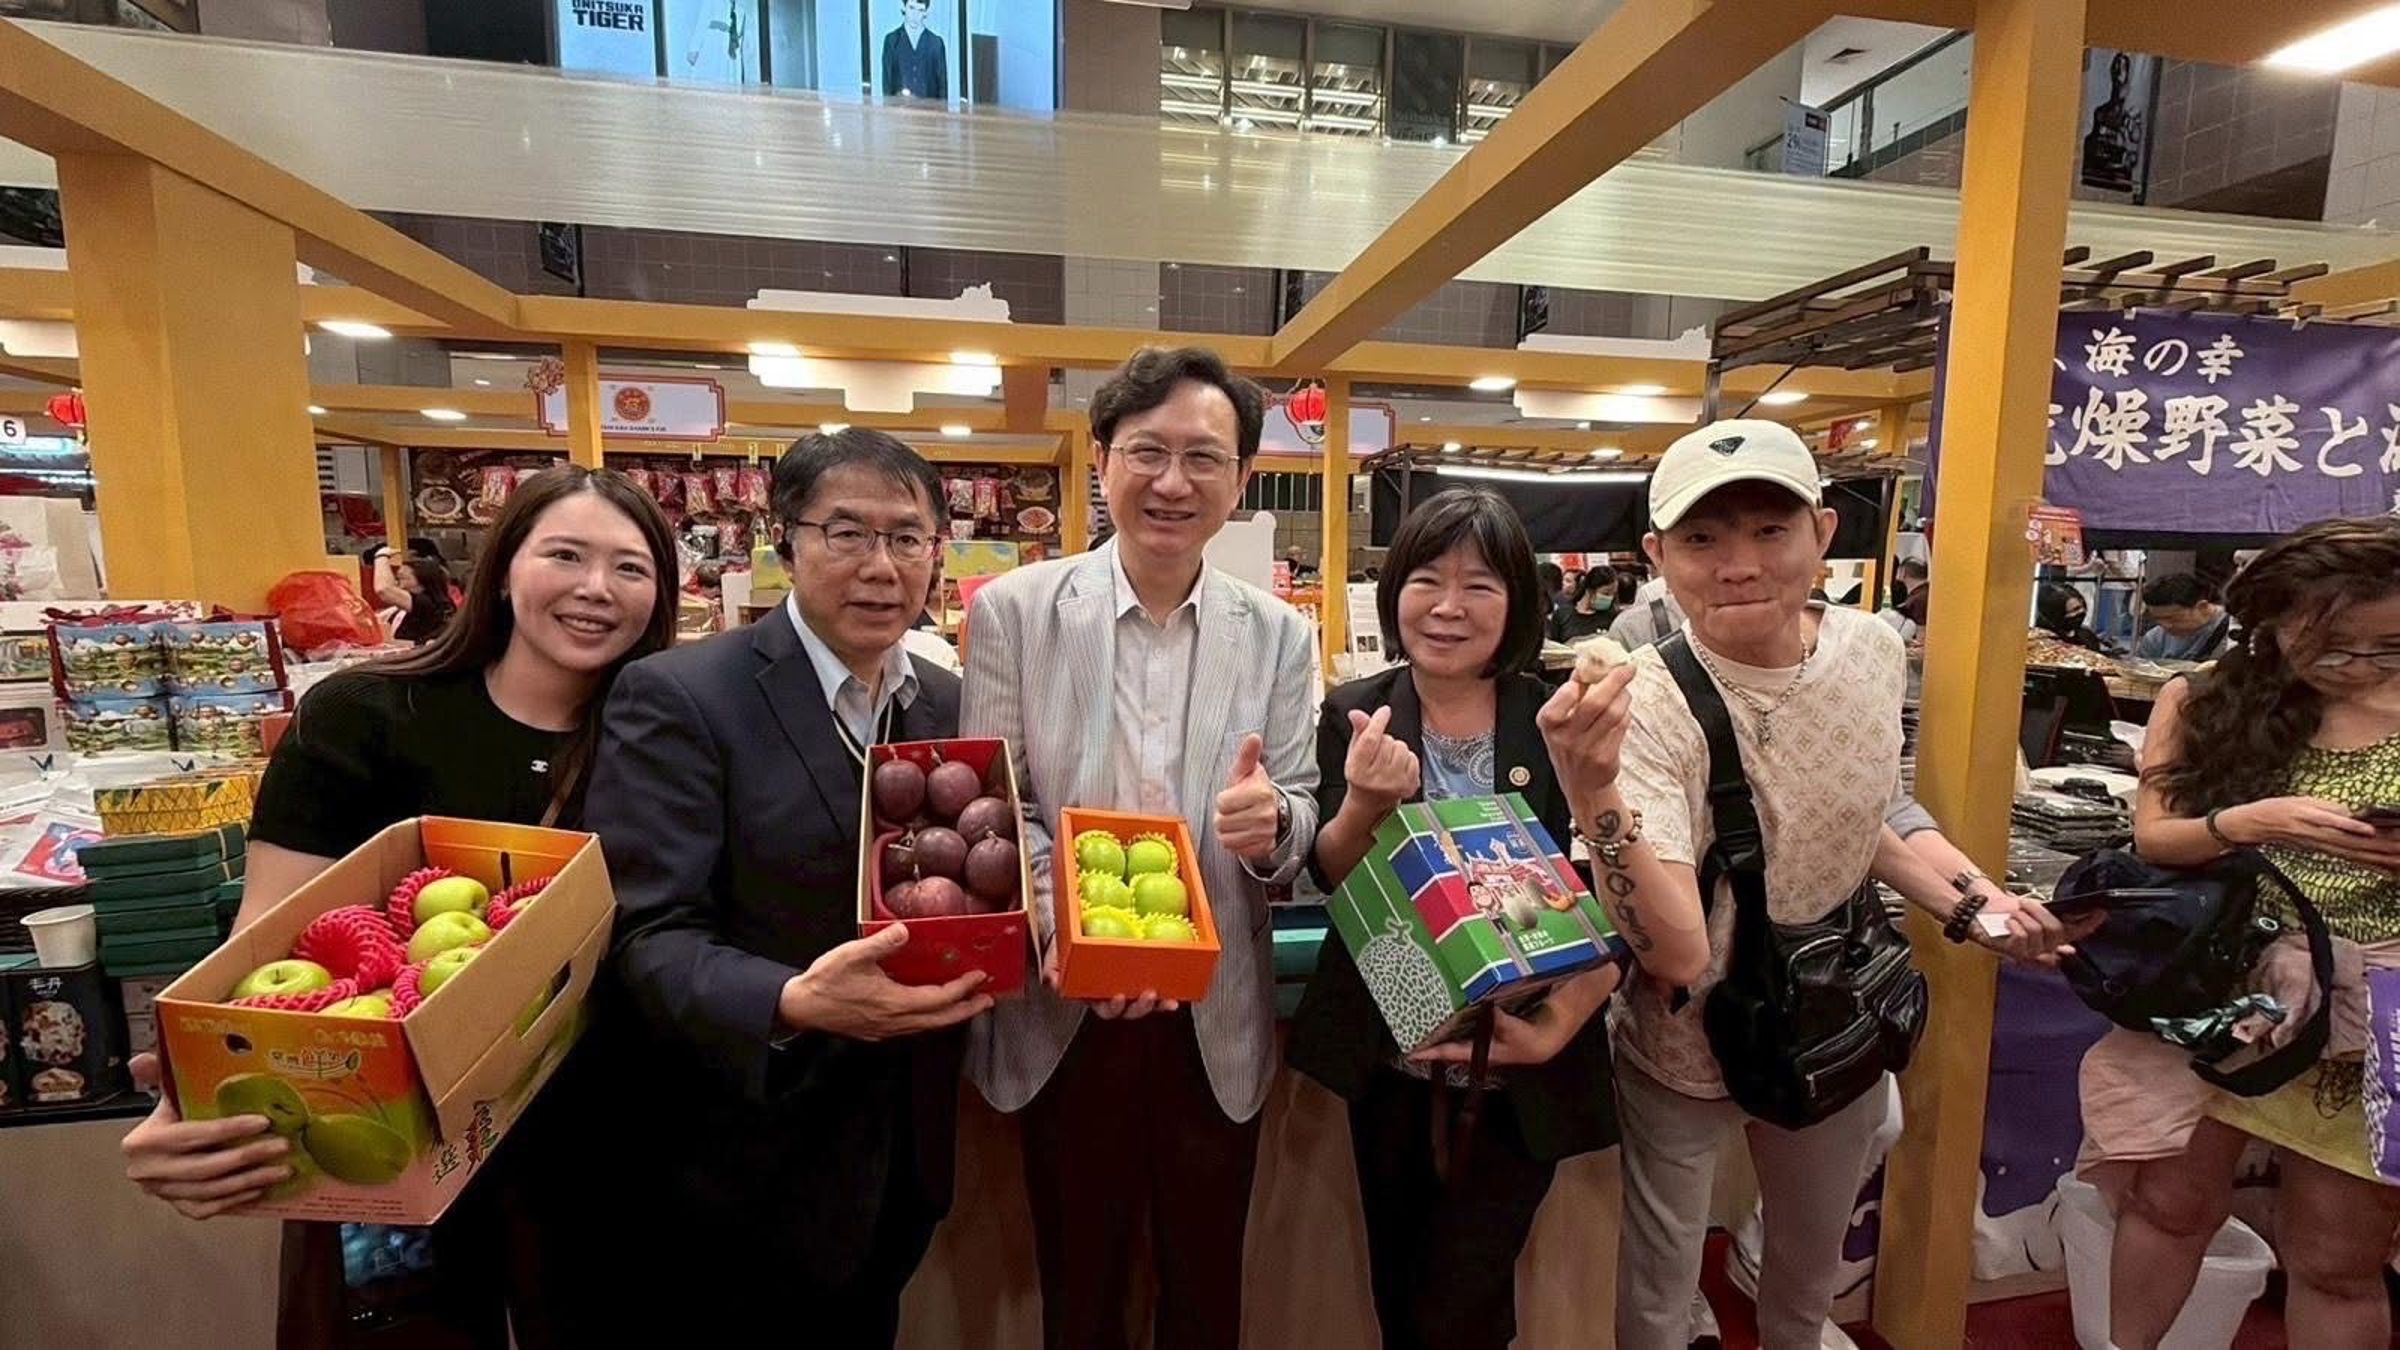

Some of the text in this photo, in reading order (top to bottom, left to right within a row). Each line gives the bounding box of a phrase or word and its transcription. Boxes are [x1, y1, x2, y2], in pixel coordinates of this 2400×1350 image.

[572, 0, 644, 14] ONITSUKA
[572, 9, 644, 32] TIGER
[3, 419, 17, 438] 6
[2045, 386, 2400, 478] 燥野菜と
